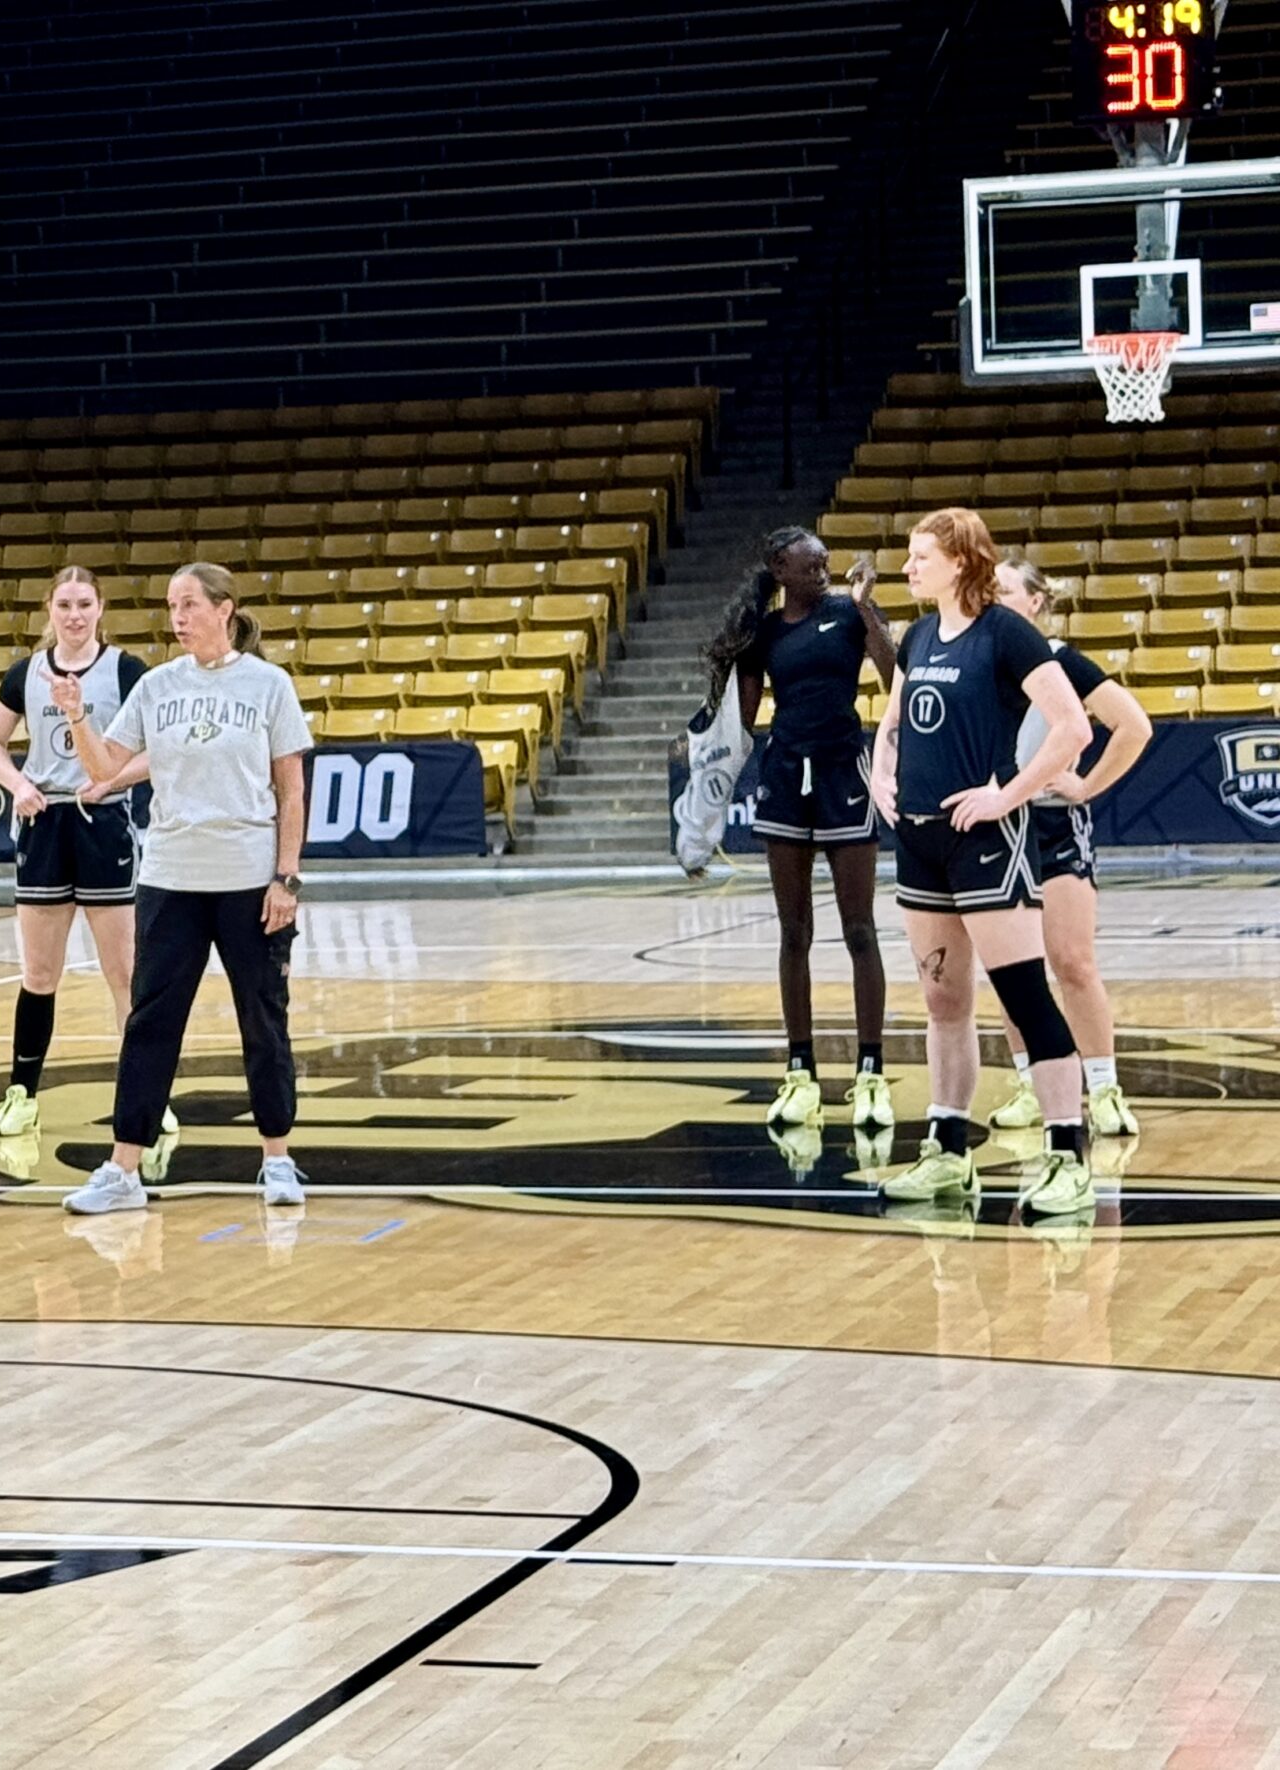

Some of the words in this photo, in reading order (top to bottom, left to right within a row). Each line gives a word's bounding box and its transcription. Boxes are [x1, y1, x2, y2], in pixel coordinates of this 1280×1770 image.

[1108, 0, 1201, 39] 4:19
[1106, 42, 1183, 112] 30
[908, 666, 961, 683] COLORADO
[157, 697, 258, 733] COLORADO
[917, 694, 935, 722] 17
[64, 730, 74, 750] 8
